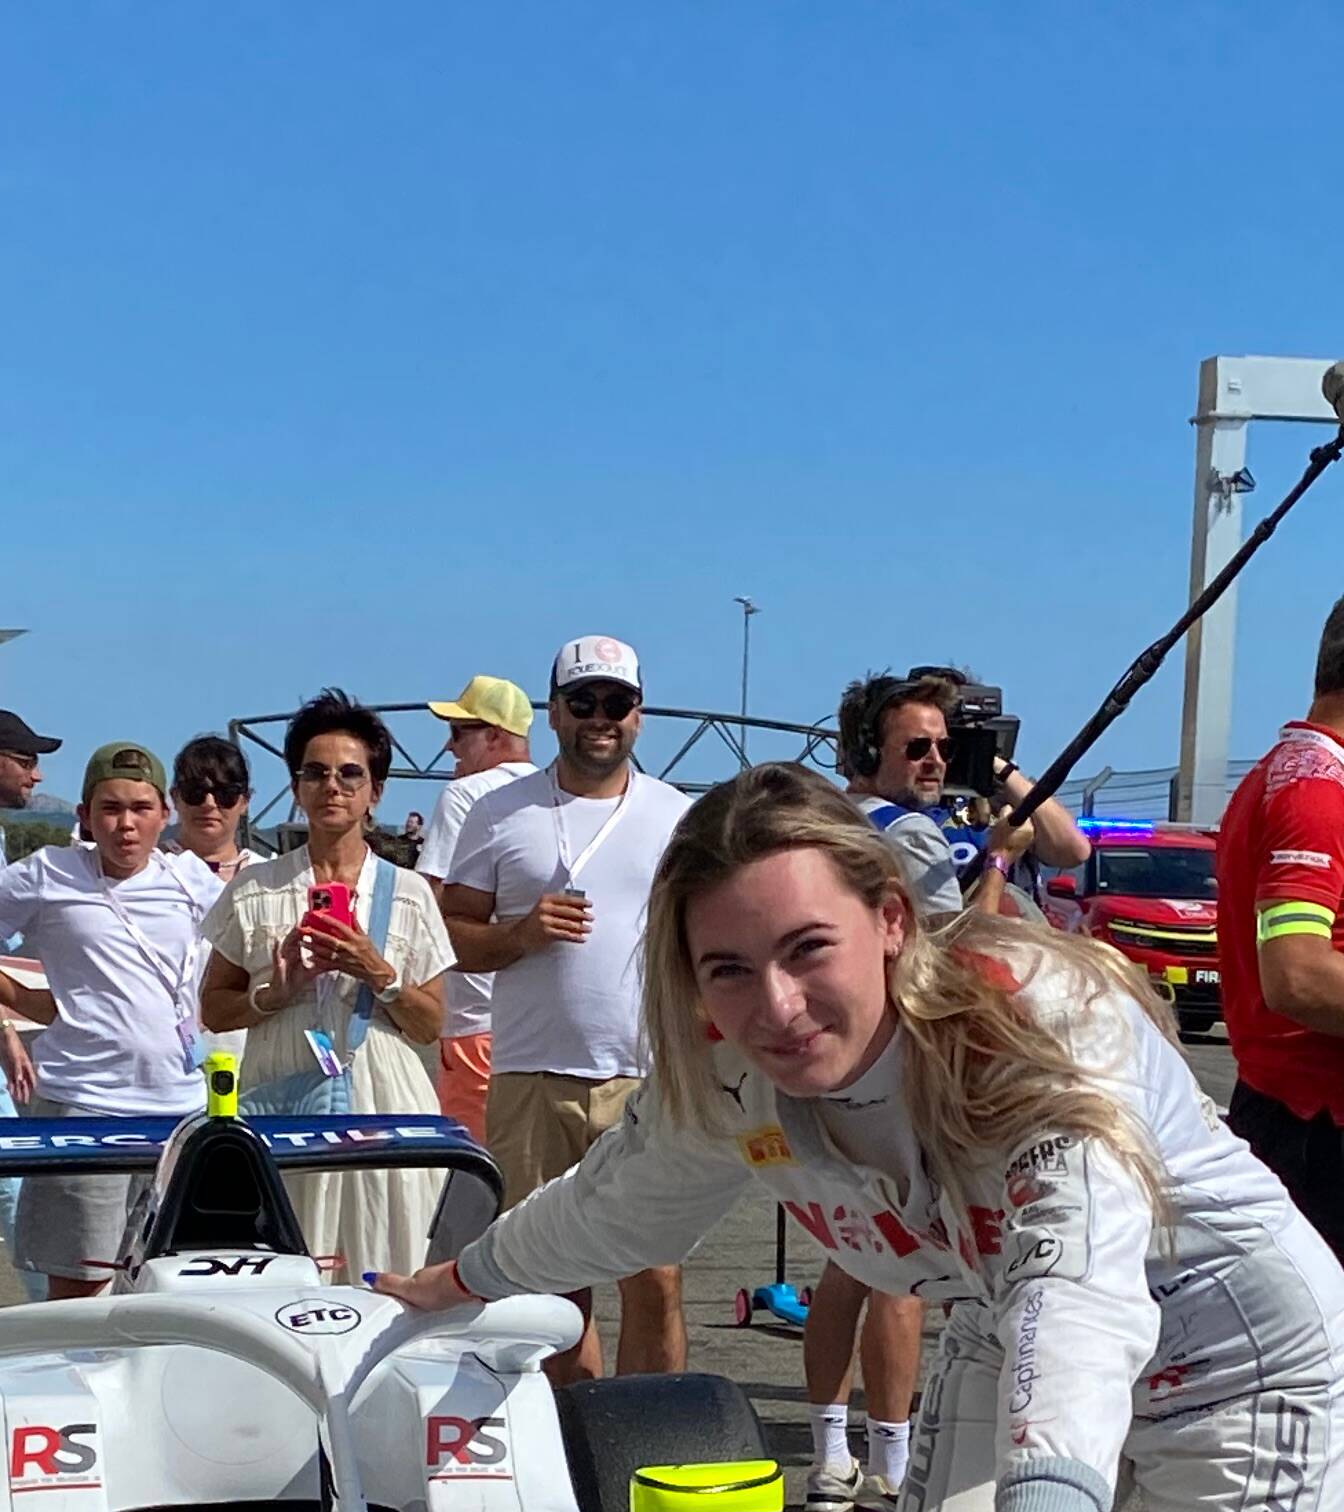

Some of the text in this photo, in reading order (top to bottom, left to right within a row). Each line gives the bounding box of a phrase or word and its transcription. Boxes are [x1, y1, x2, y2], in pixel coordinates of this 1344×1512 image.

[289, 1308, 352, 1328] ETC
[10, 1423, 97, 1478] RS
[426, 1416, 507, 1466] RS
